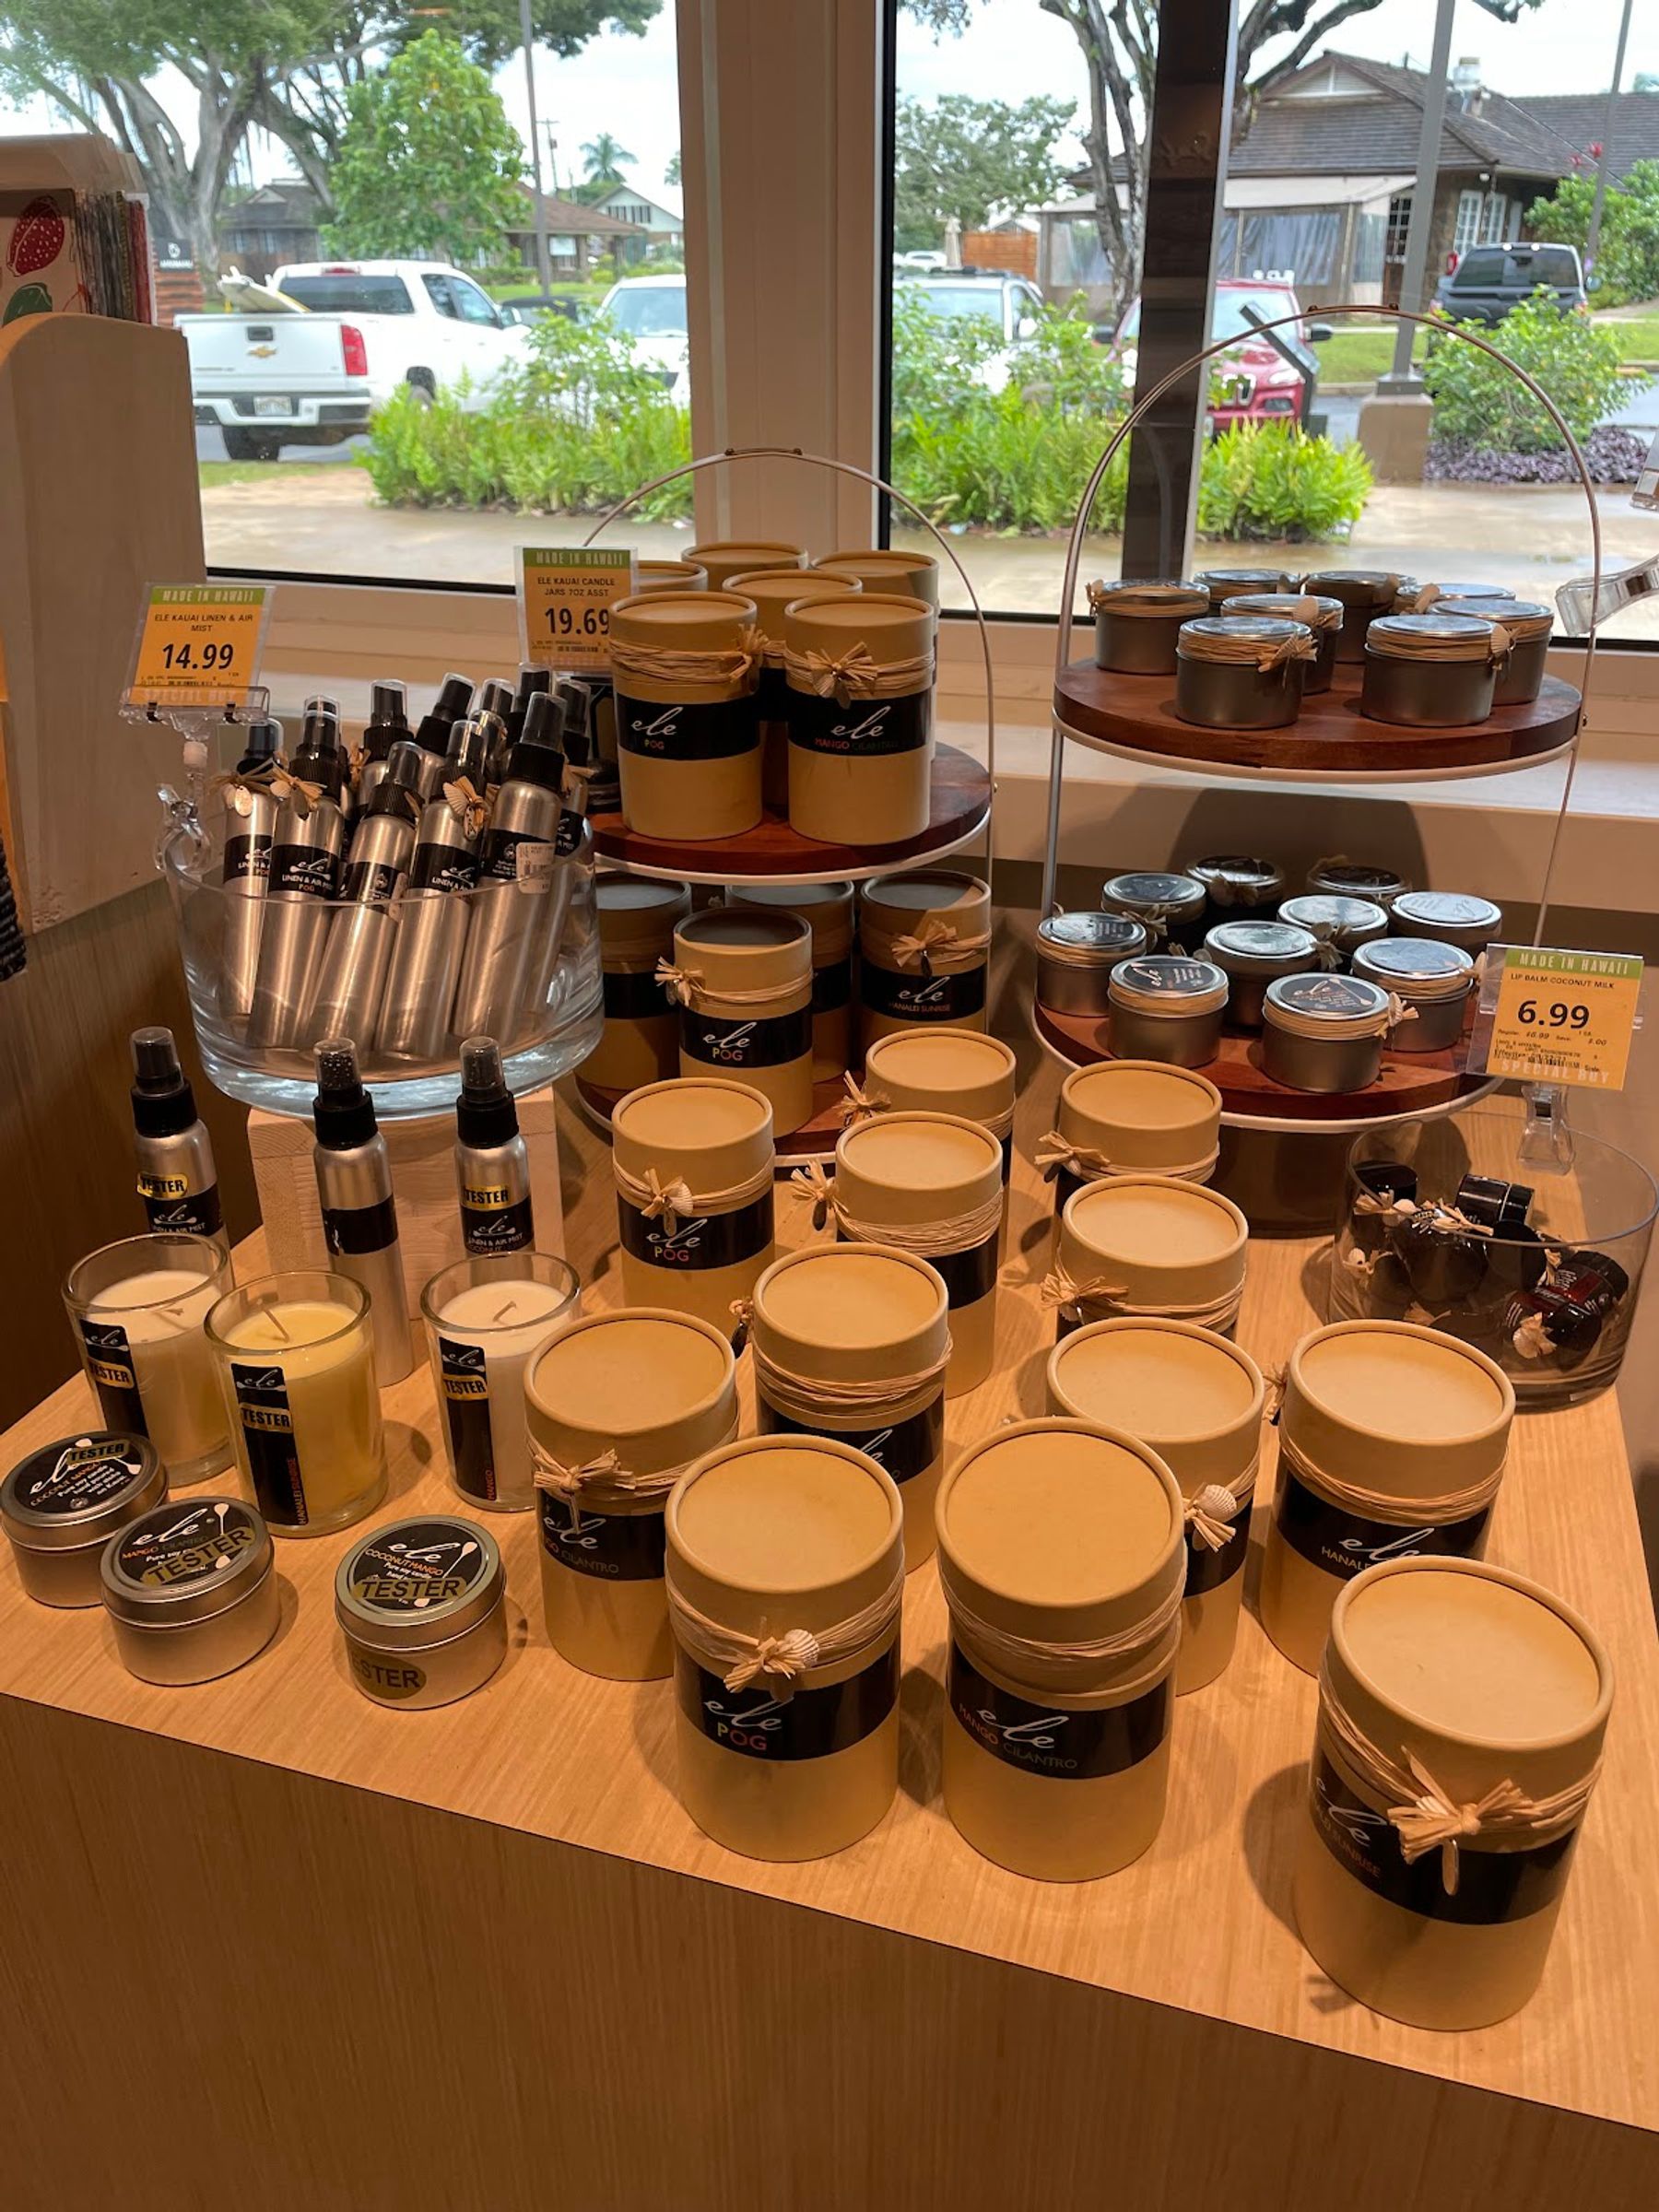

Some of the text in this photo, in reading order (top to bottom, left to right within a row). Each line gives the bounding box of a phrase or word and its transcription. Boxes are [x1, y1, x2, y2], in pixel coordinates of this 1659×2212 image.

[536, 552, 622, 566] MADE IN HAWAII
[537, 577, 615, 586] ELE KAUAI CANDLE
[162, 590, 253, 603] MADE IN HAWAII
[545, 588, 565, 596] JARS
[587, 589, 609, 597] ASST
[155, 614, 170, 622] ELE
[171, 614, 199, 622] KAUAI
[202, 614, 226, 622] LINEN
[238, 614, 253, 622] AIR
[545, 607, 609, 635] 19.69
[162, 643, 234, 670] 14.99
[631, 707, 684, 735] ele
[830, 705, 891, 739] ele
[644, 739, 665, 750] POG
[282, 875, 304, 883] LINEN
[1519, 953, 1629, 975] MADE IN HAWAII
[898, 976, 950, 1004] ele
[1549, 977, 1592, 987] COCONUT
[1594, 981, 1615, 989] MILK
[1518, 1000, 1590, 1030] 6.99
[702, 1021, 758, 1048] ele
[712, 1047, 743, 1061] POG
[1501, 1060, 1609, 1083] SPECIAL BUY
[142, 1177, 184, 1193] TESTER
[465, 1189, 509, 1205] TESTER
[646, 1218, 708, 1248] ele
[654, 1246, 689, 1262] POG
[443, 1379, 487, 1394] TESTER
[241, 1407, 290, 1428] TESTER
[71, 1443, 124, 1461] TESTER
[132, 1508, 208, 1546] ele
[122, 1546, 159, 1559] MANGO
[146, 1554, 165, 1562] Pure
[167, 1550, 182, 1559] soy
[147, 1530, 252, 1585] TESTER
[365, 1548, 443, 1576] COCONUT MANGO
[388, 1543, 461, 1563] ele
[1321, 1546, 1372, 1571] HANALE
[383, 1561, 399, 1571] Pure
[362, 1581, 461, 1598] TESTER
[703, 1697, 794, 1731] ele
[717, 1721, 768, 1751] POG
[959, 1702, 1077, 1770] MANGO CILANTRO
[977, 1710, 1070, 1749] ele
[1316, 1776, 1388, 1847] ele
